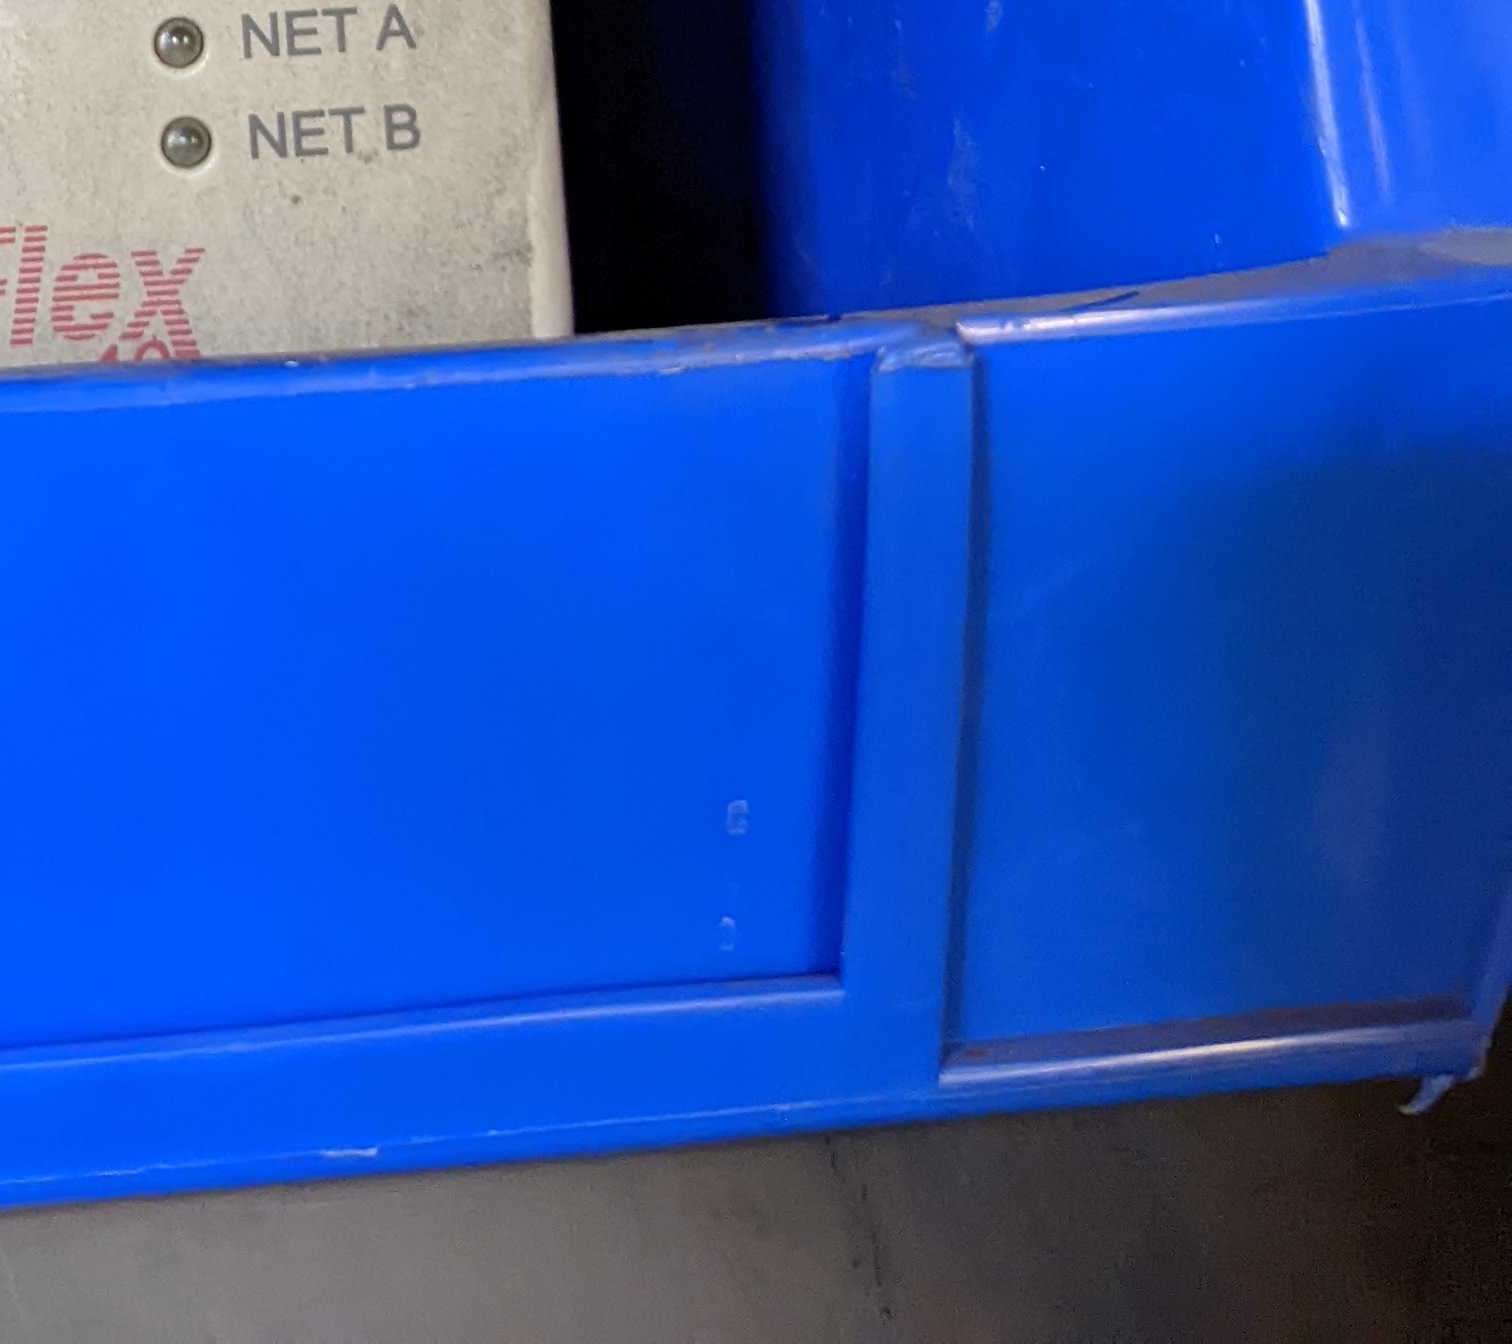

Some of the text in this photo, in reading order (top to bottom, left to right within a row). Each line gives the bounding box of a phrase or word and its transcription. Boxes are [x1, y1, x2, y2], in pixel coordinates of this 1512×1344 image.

[241, 4, 417, 59] NET A
[248, 103, 421, 160] NET B
